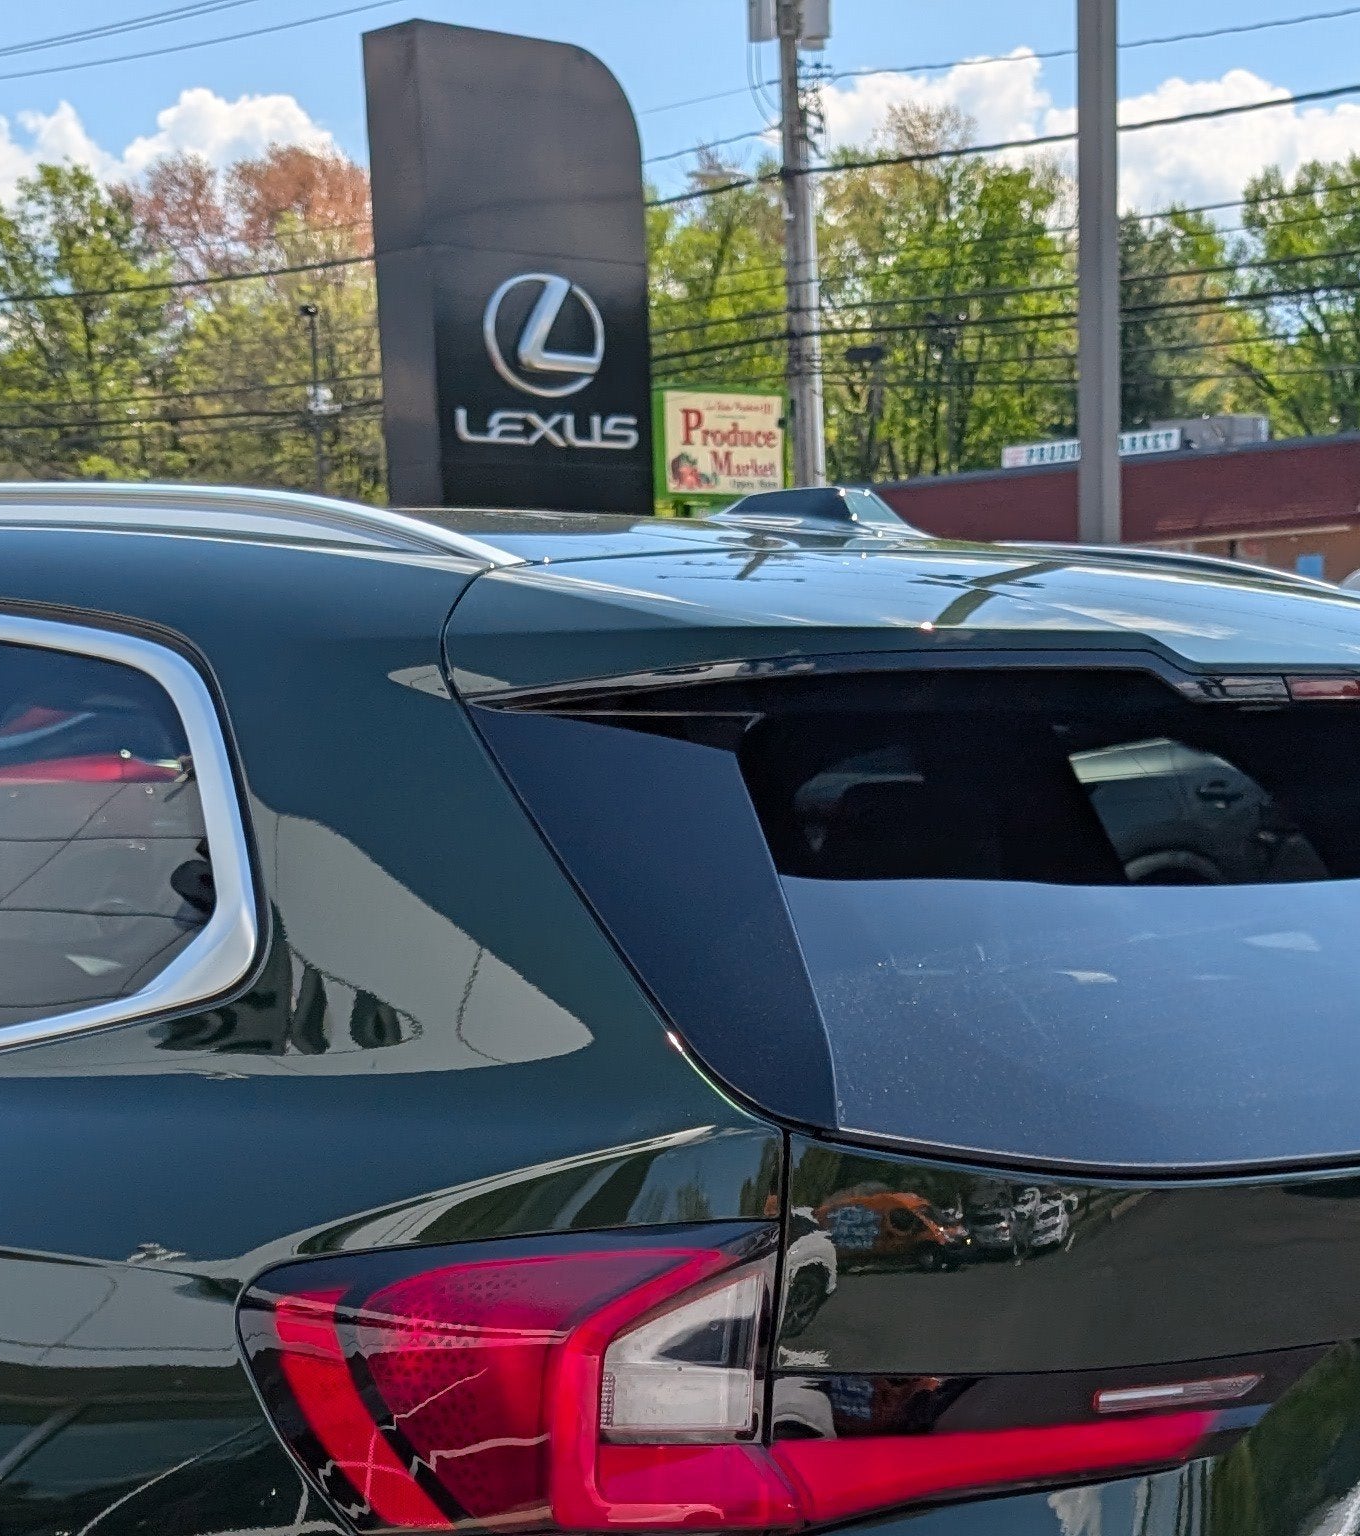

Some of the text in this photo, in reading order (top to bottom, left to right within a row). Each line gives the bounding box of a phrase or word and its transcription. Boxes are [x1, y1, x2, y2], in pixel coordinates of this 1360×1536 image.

[454, 405, 639, 449] LEXUS
[680, 407, 777, 448] Produce
[710, 450, 775, 476] Market
